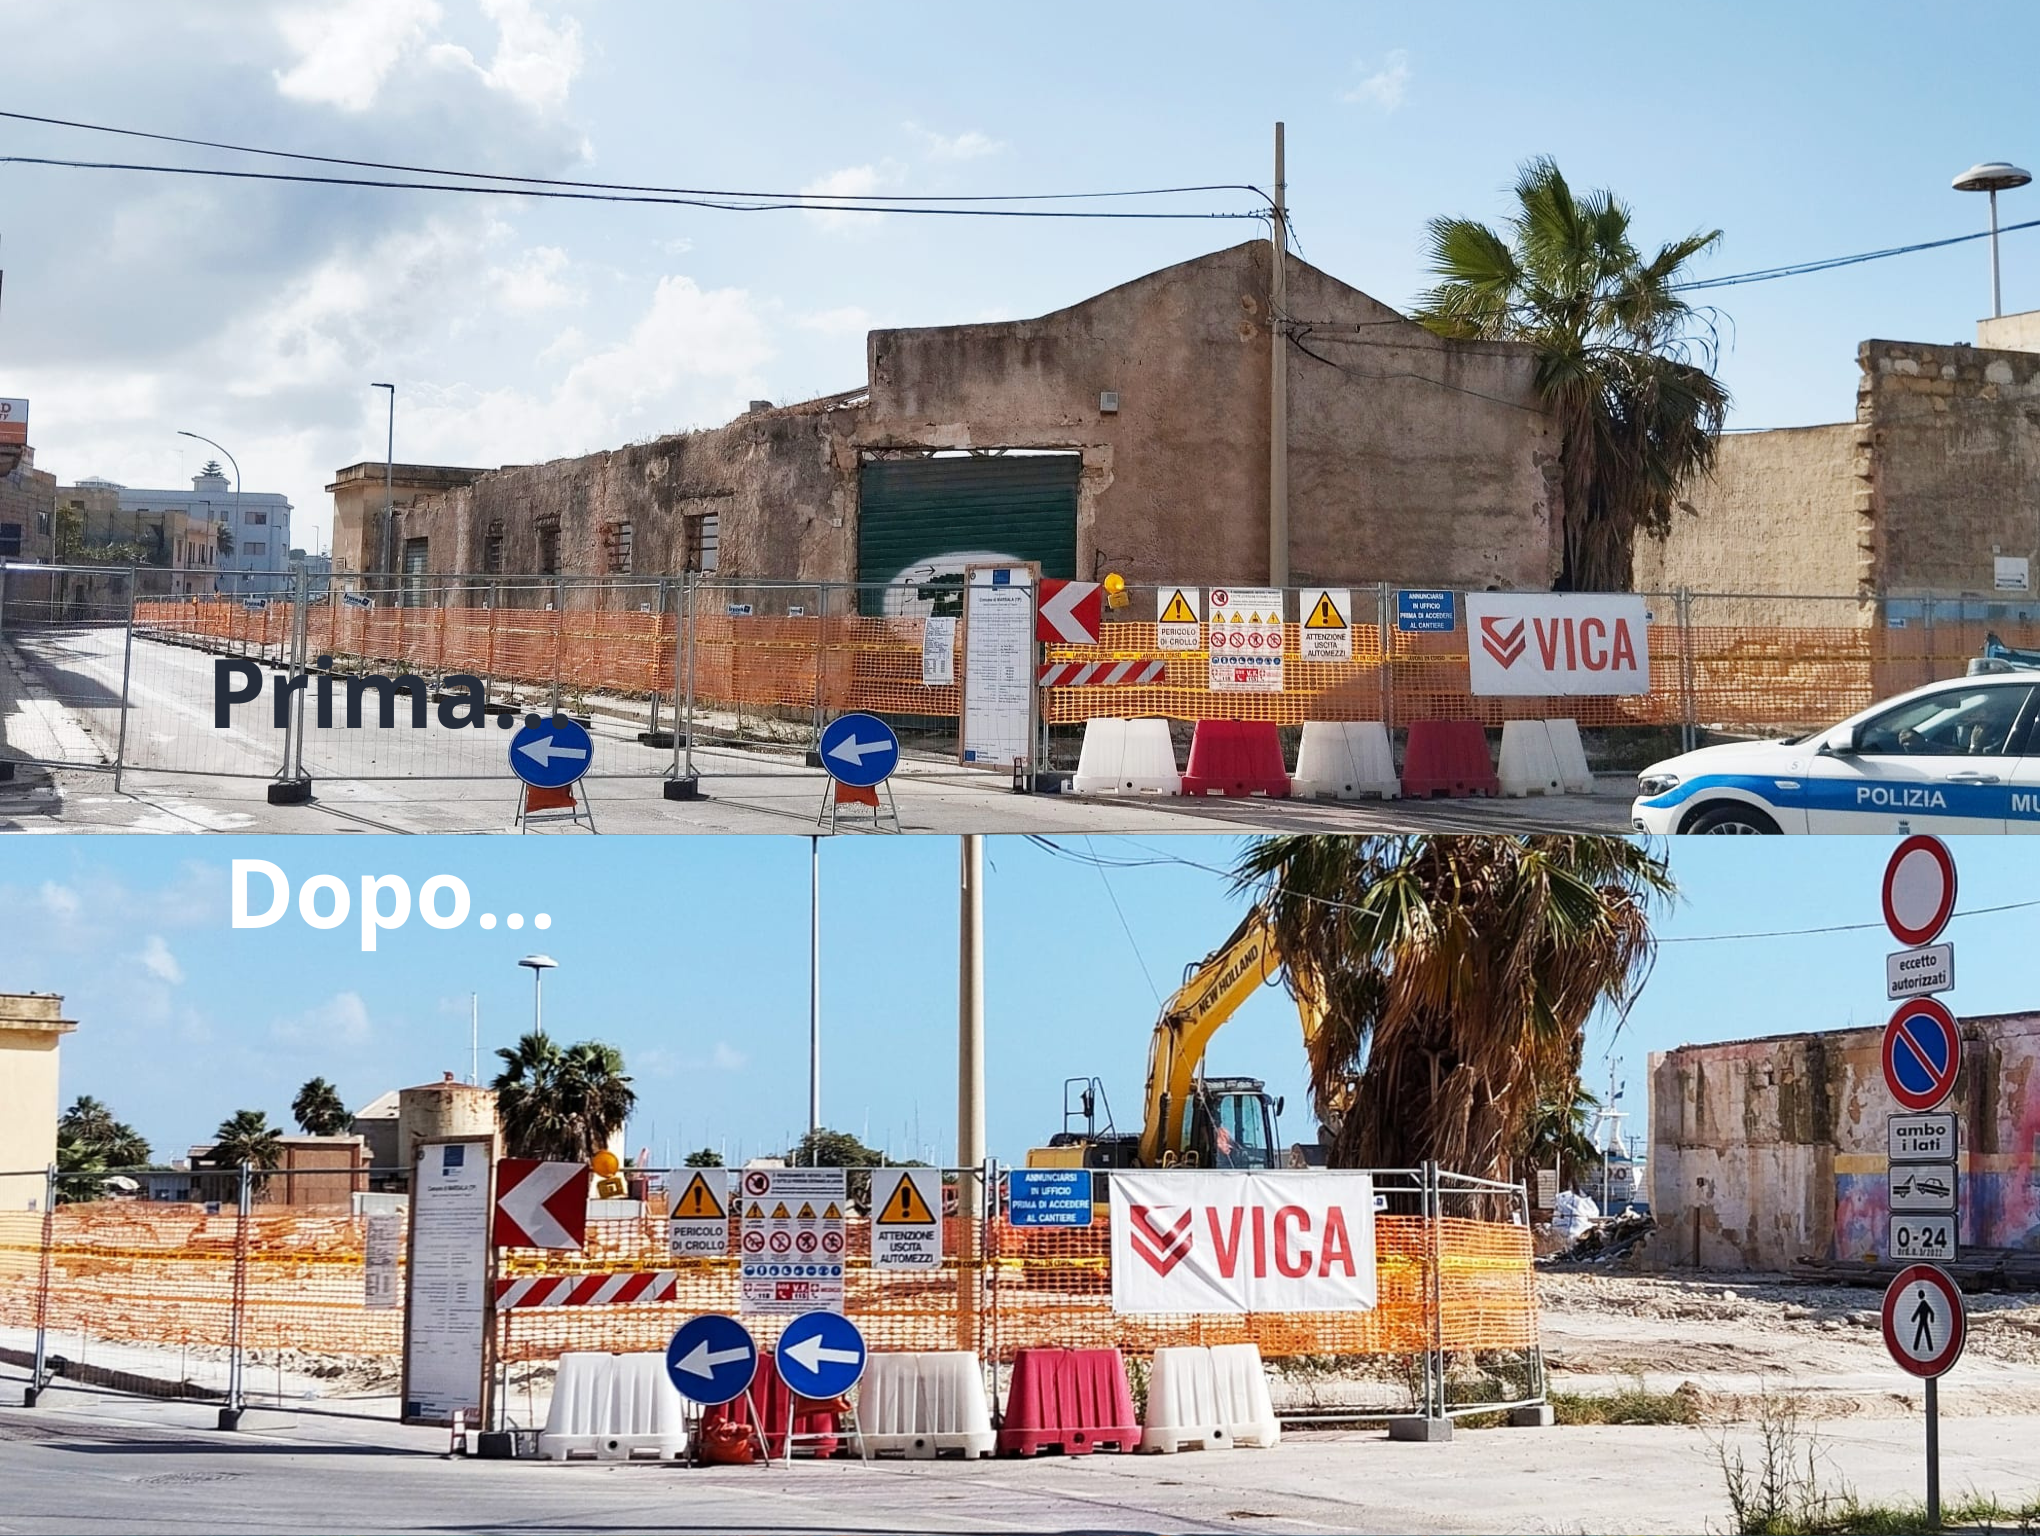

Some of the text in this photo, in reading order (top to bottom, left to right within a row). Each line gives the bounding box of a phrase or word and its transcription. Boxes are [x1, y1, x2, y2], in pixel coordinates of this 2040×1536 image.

[1161, 628, 1196, 636] PERICOLO
[1306, 633, 1346, 641] ATTENZIONE
[1169, 638, 1198, 646] CROLLO
[1314, 641, 1338, 649] USCITA
[1532, 617, 1638, 671] VICA
[1857, 787, 1947, 809] POLIZIA
[1899, 954, 1937, 971] eccetto
[1198, 944, 1259, 1017] NEW HOLLAND
[1891, 970, 1947, 992] autorizzati
[1896, 1123, 1946, 1137] ambo
[1902, 1138, 1941, 1151] i lati
[1025, 1173, 1078, 1182] ANNUNCIARSI
[1030, 1187, 1072, 1195] IN UFFICIO
[1012, 1200, 1090, 1209] PRIMA DI ACCEDERE
[1026, 1213, 1077, 1222] AL CANTIERE
[674, 1226, 723, 1236] PERICOLO
[878, 1230, 935, 1241] ATTENZIONE
[672, 1240, 725, 1250] DI CROLLO
[890, 1242, 922, 1252] USCITA
[1205, 1205, 1357, 1279] VICA
[880, 1254, 933, 1263] AUTOMEZZI
